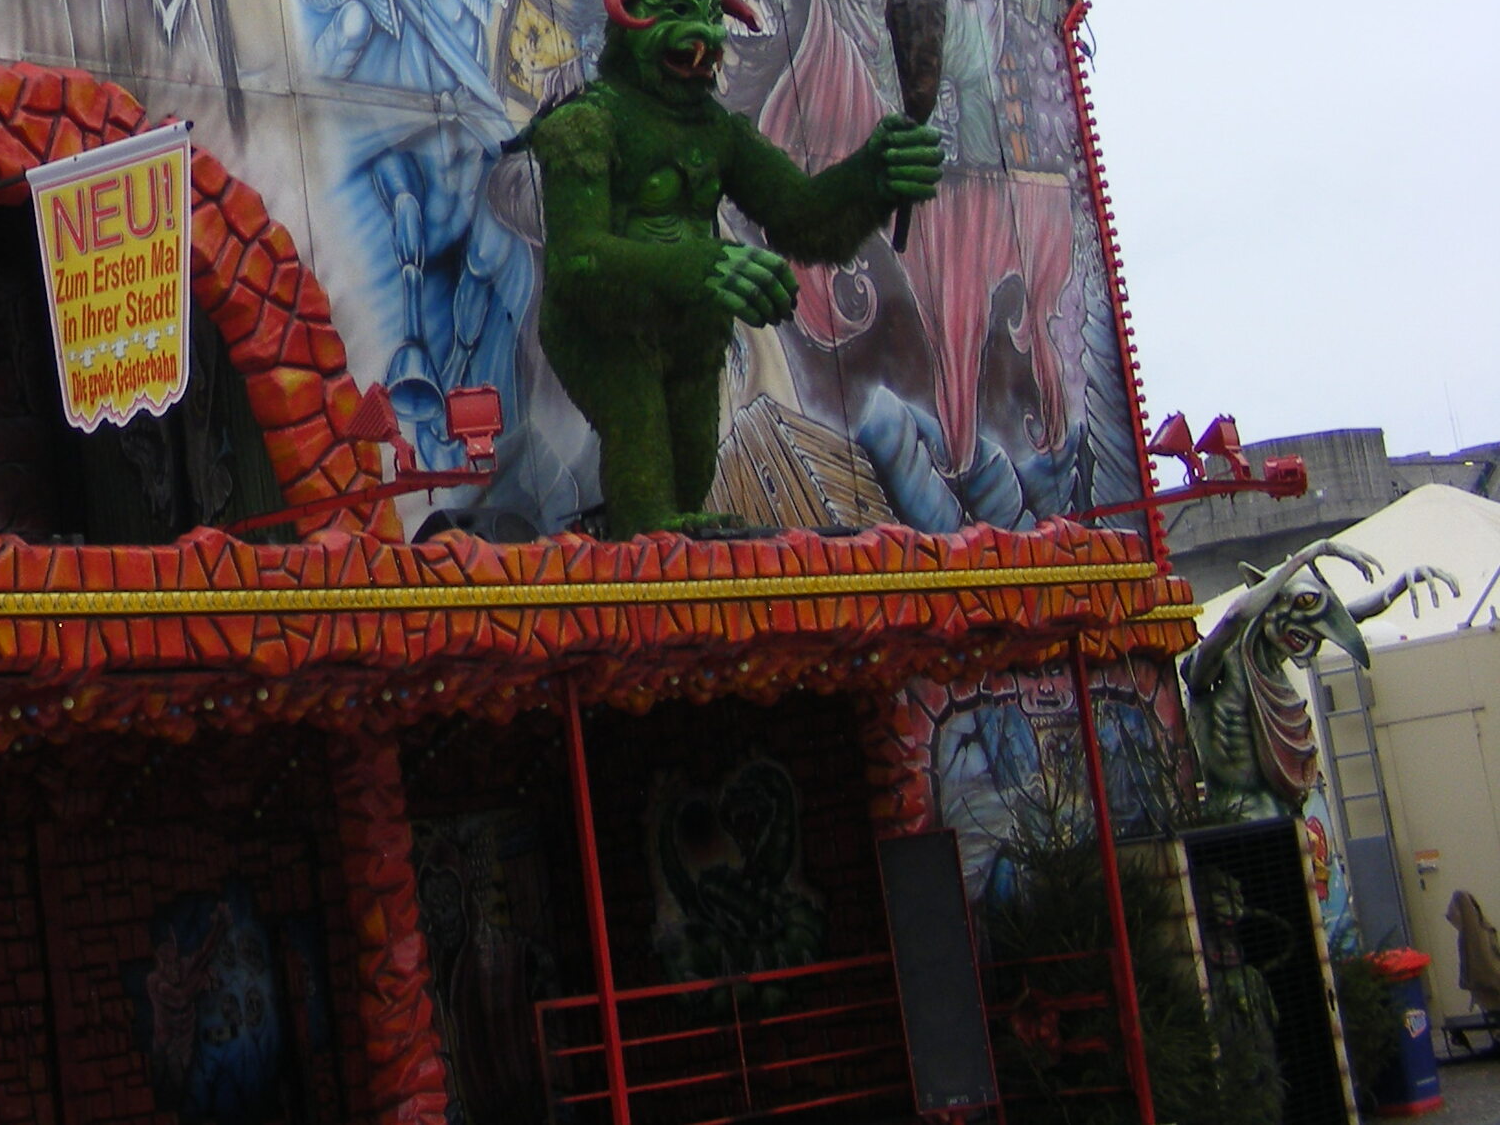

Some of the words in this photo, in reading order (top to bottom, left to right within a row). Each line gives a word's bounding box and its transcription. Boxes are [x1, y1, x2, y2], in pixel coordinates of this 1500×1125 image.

[51, 160, 175, 262] NEU!
[55, 268, 88, 305] Zum
[93, 253, 146, 295] Ersten
[151, 235, 180, 276] Mal
[63, 309, 77, 345] in
[82, 300, 121, 339] Ihrer
[126, 280, 177, 326] Stadt!
[72, 370, 88, 403] Die
[89, 362, 114, 406] große
[115, 349, 178, 401] Geisterbahn
